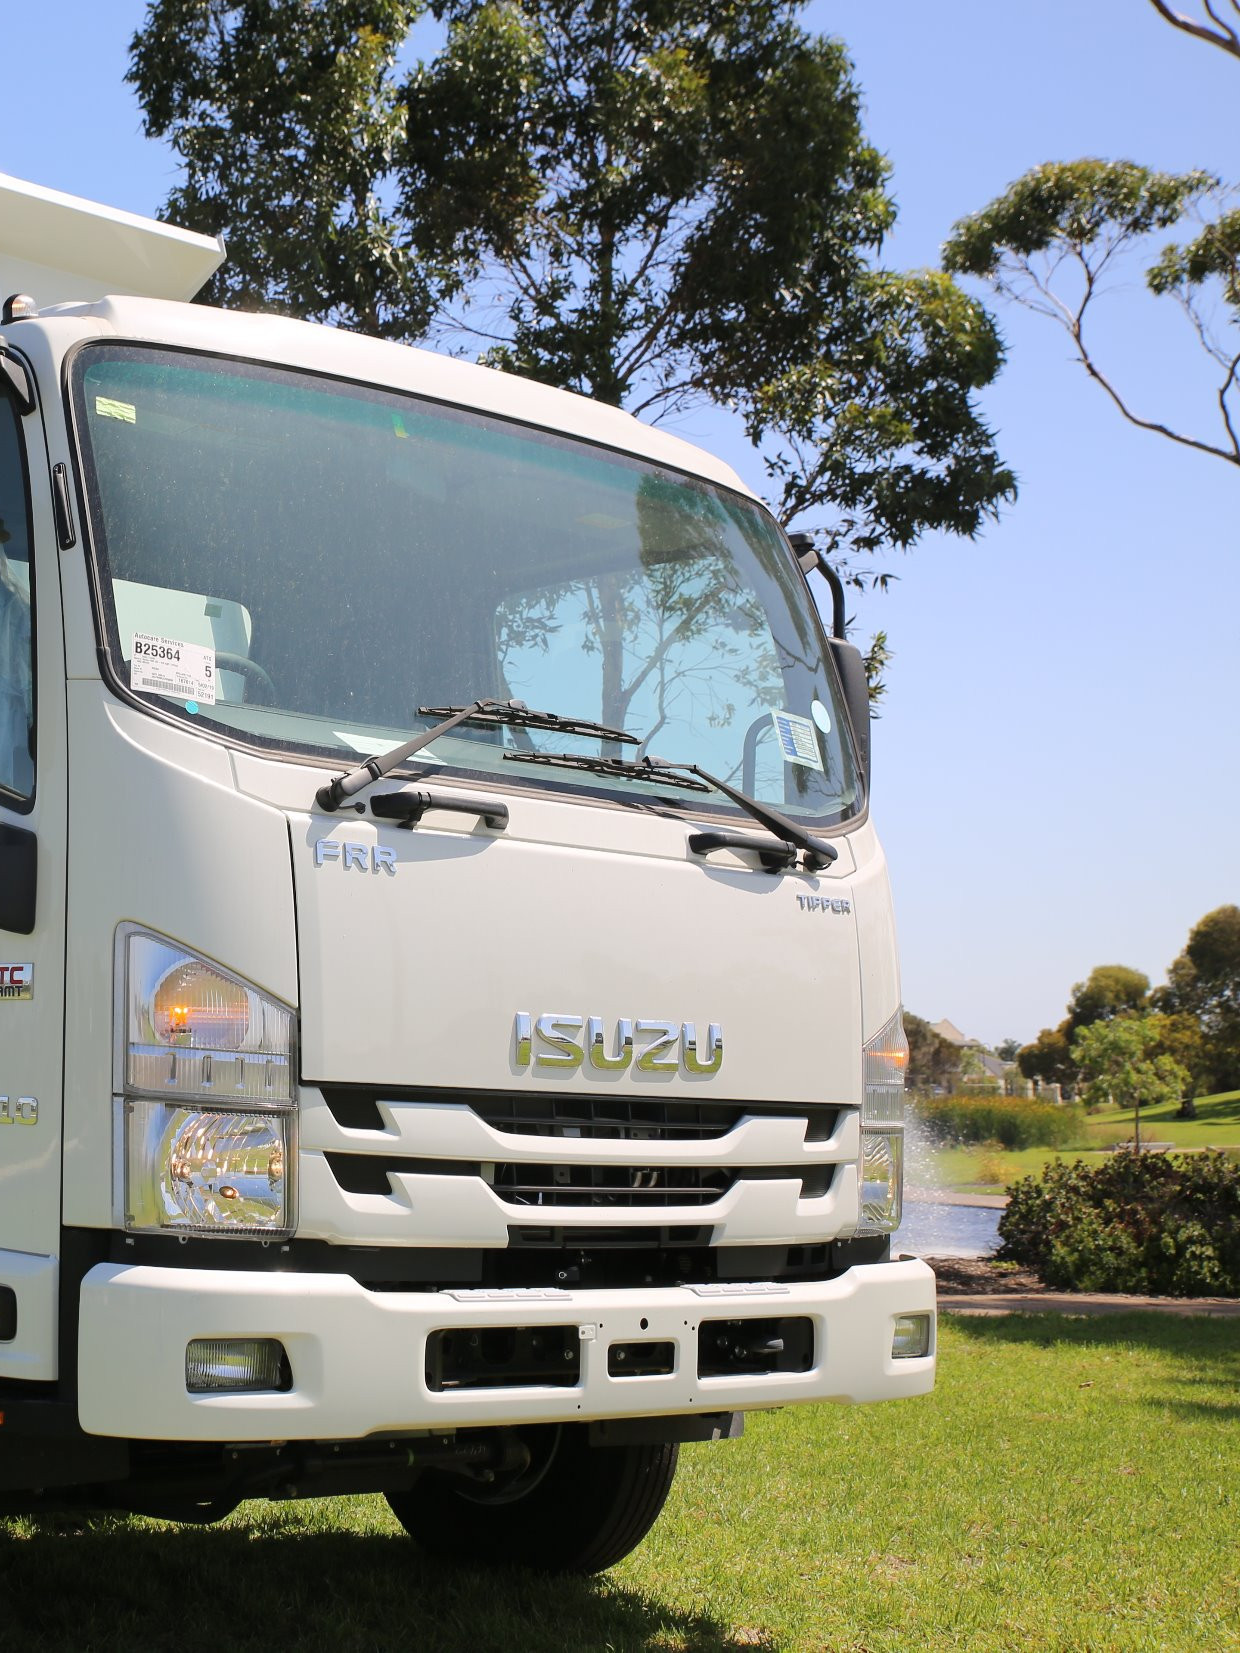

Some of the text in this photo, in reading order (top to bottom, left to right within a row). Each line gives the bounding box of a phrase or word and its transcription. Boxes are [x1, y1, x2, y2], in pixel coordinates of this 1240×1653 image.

[134, 632, 184, 648] Autocare Services
[135, 641, 181, 662] B25364
[204, 665, 212, 678] 5
[315, 839, 397, 873] FRR
[796, 894, 851, 915] TIPPER
[515, 1011, 723, 1074] ISUZU
